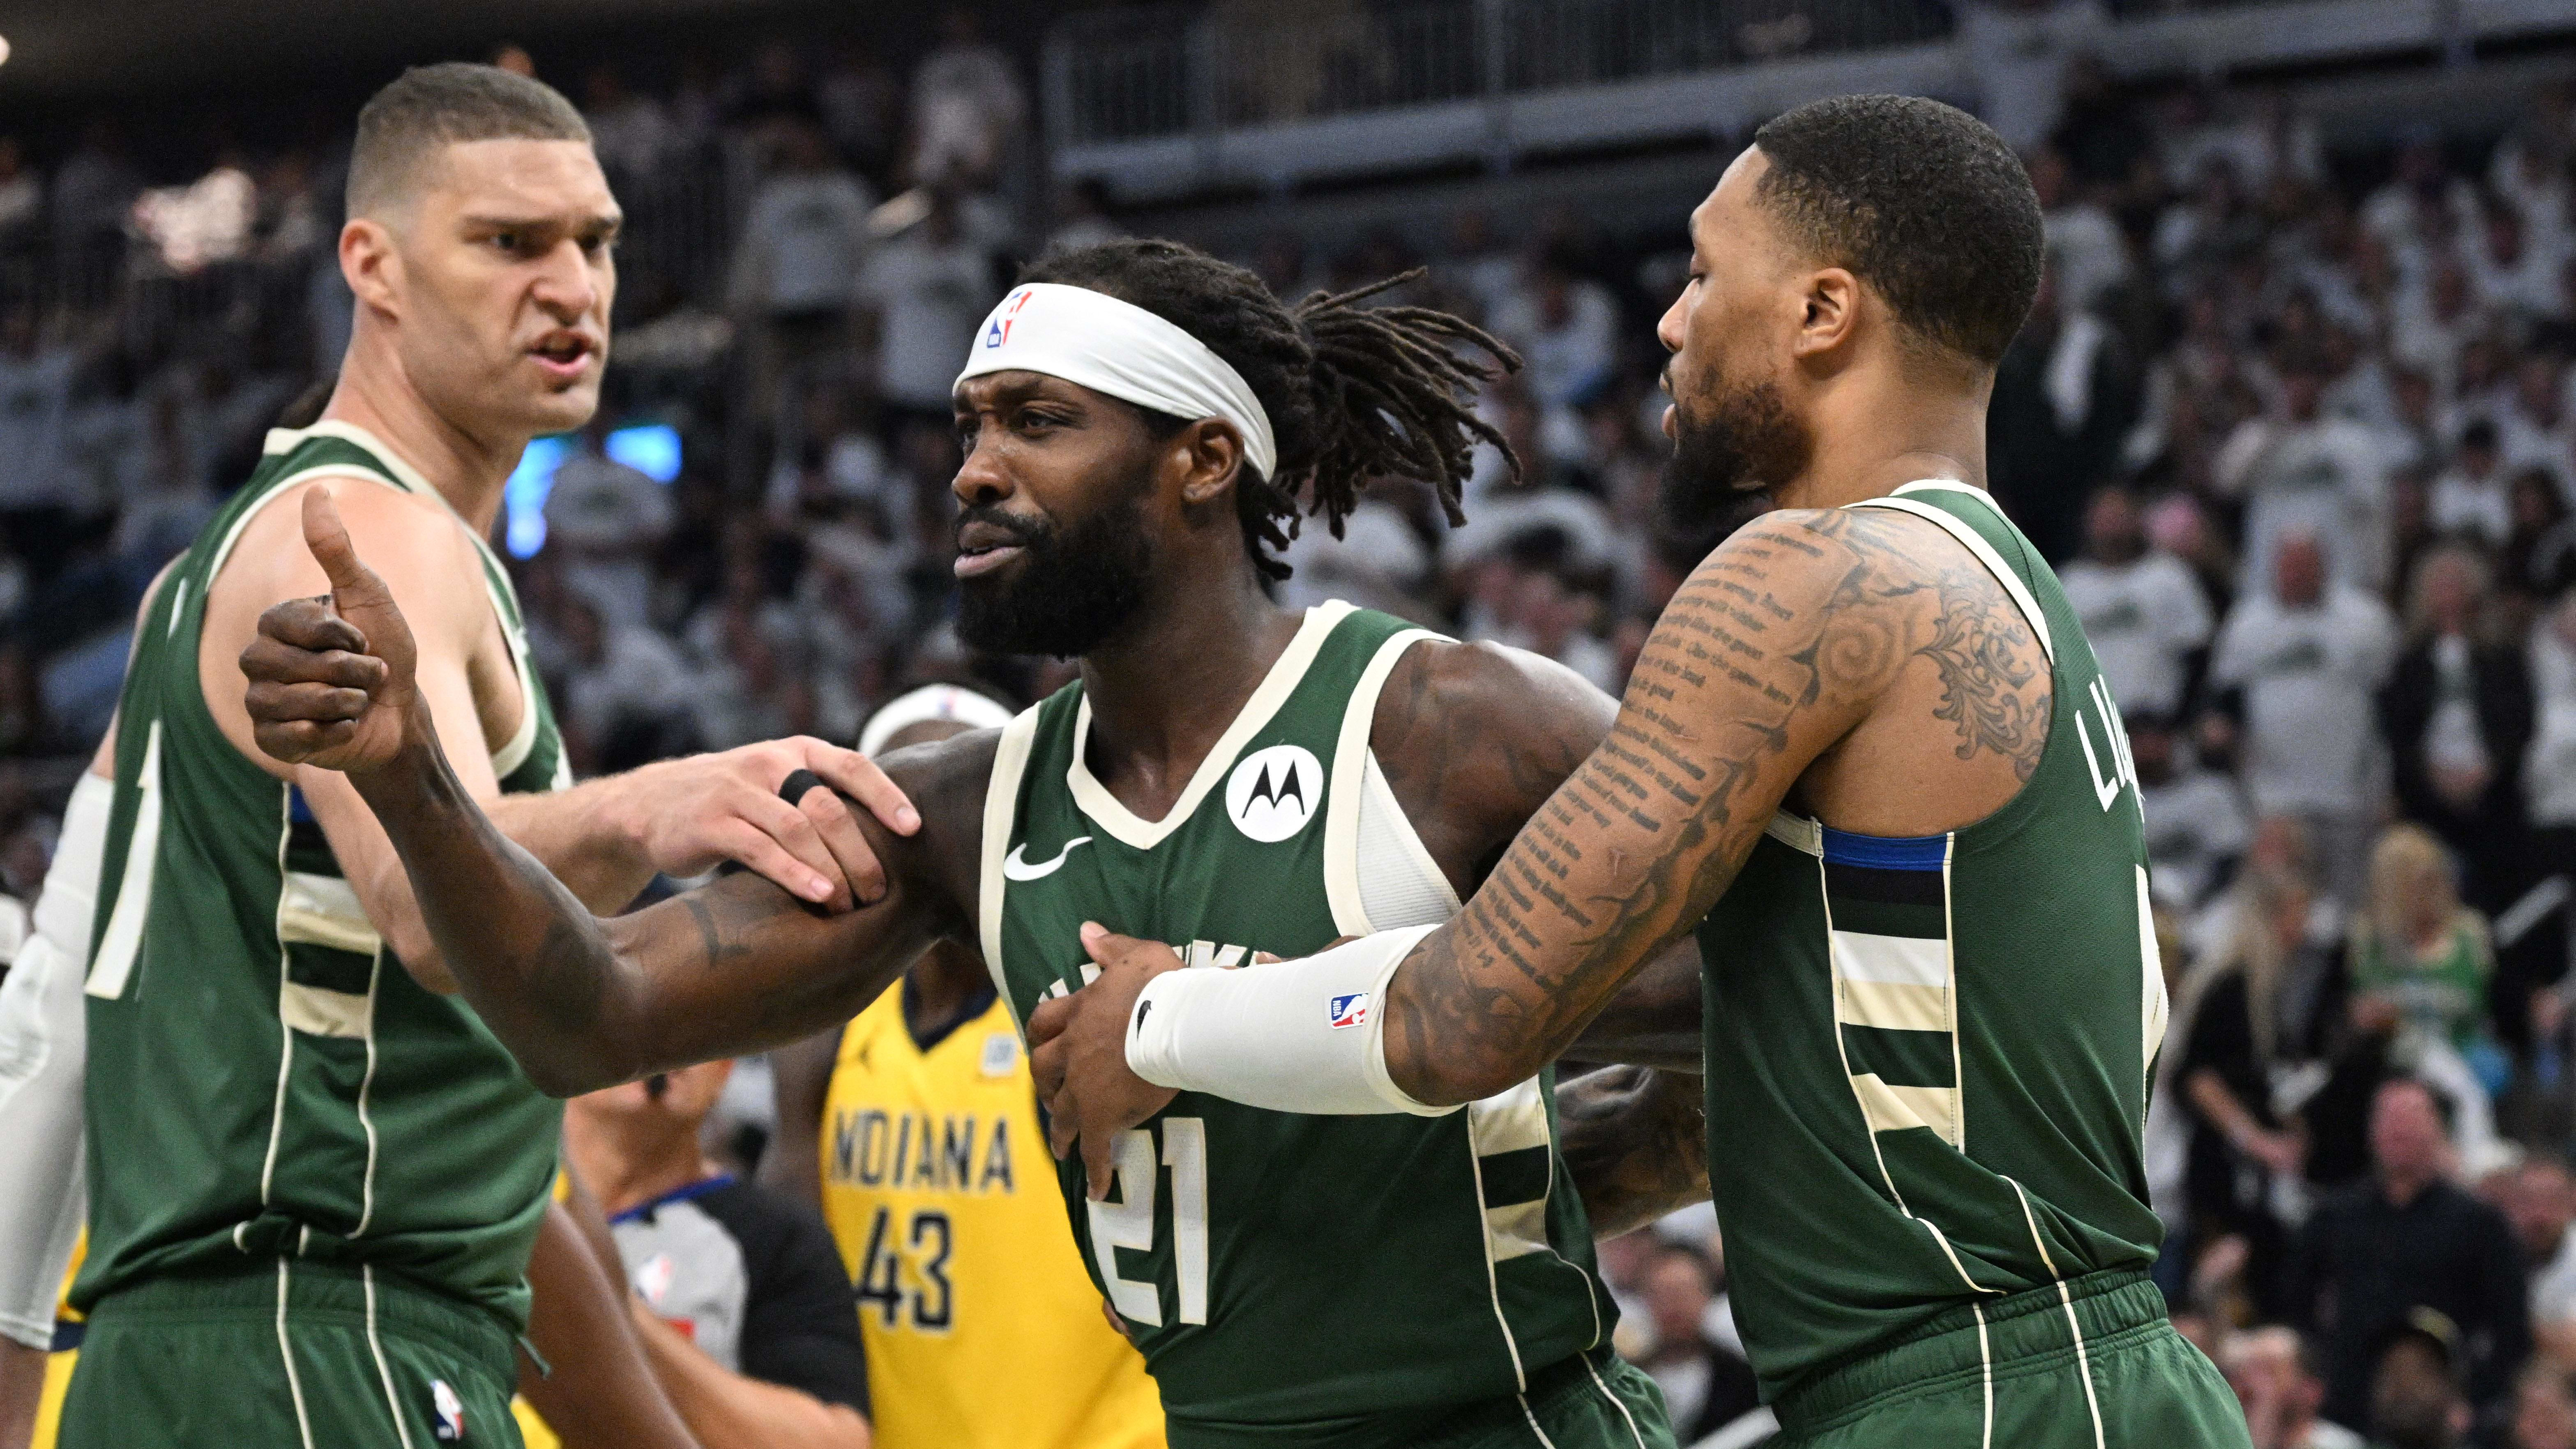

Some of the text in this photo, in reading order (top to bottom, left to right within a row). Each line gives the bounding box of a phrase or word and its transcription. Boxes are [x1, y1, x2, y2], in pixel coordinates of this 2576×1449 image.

[1332, 1000, 1342, 1017] NBA
[832, 1108, 1012, 1191] NDIANA
[855, 1206, 951, 1328] 43
[1085, 1117, 1208, 1327] 21
